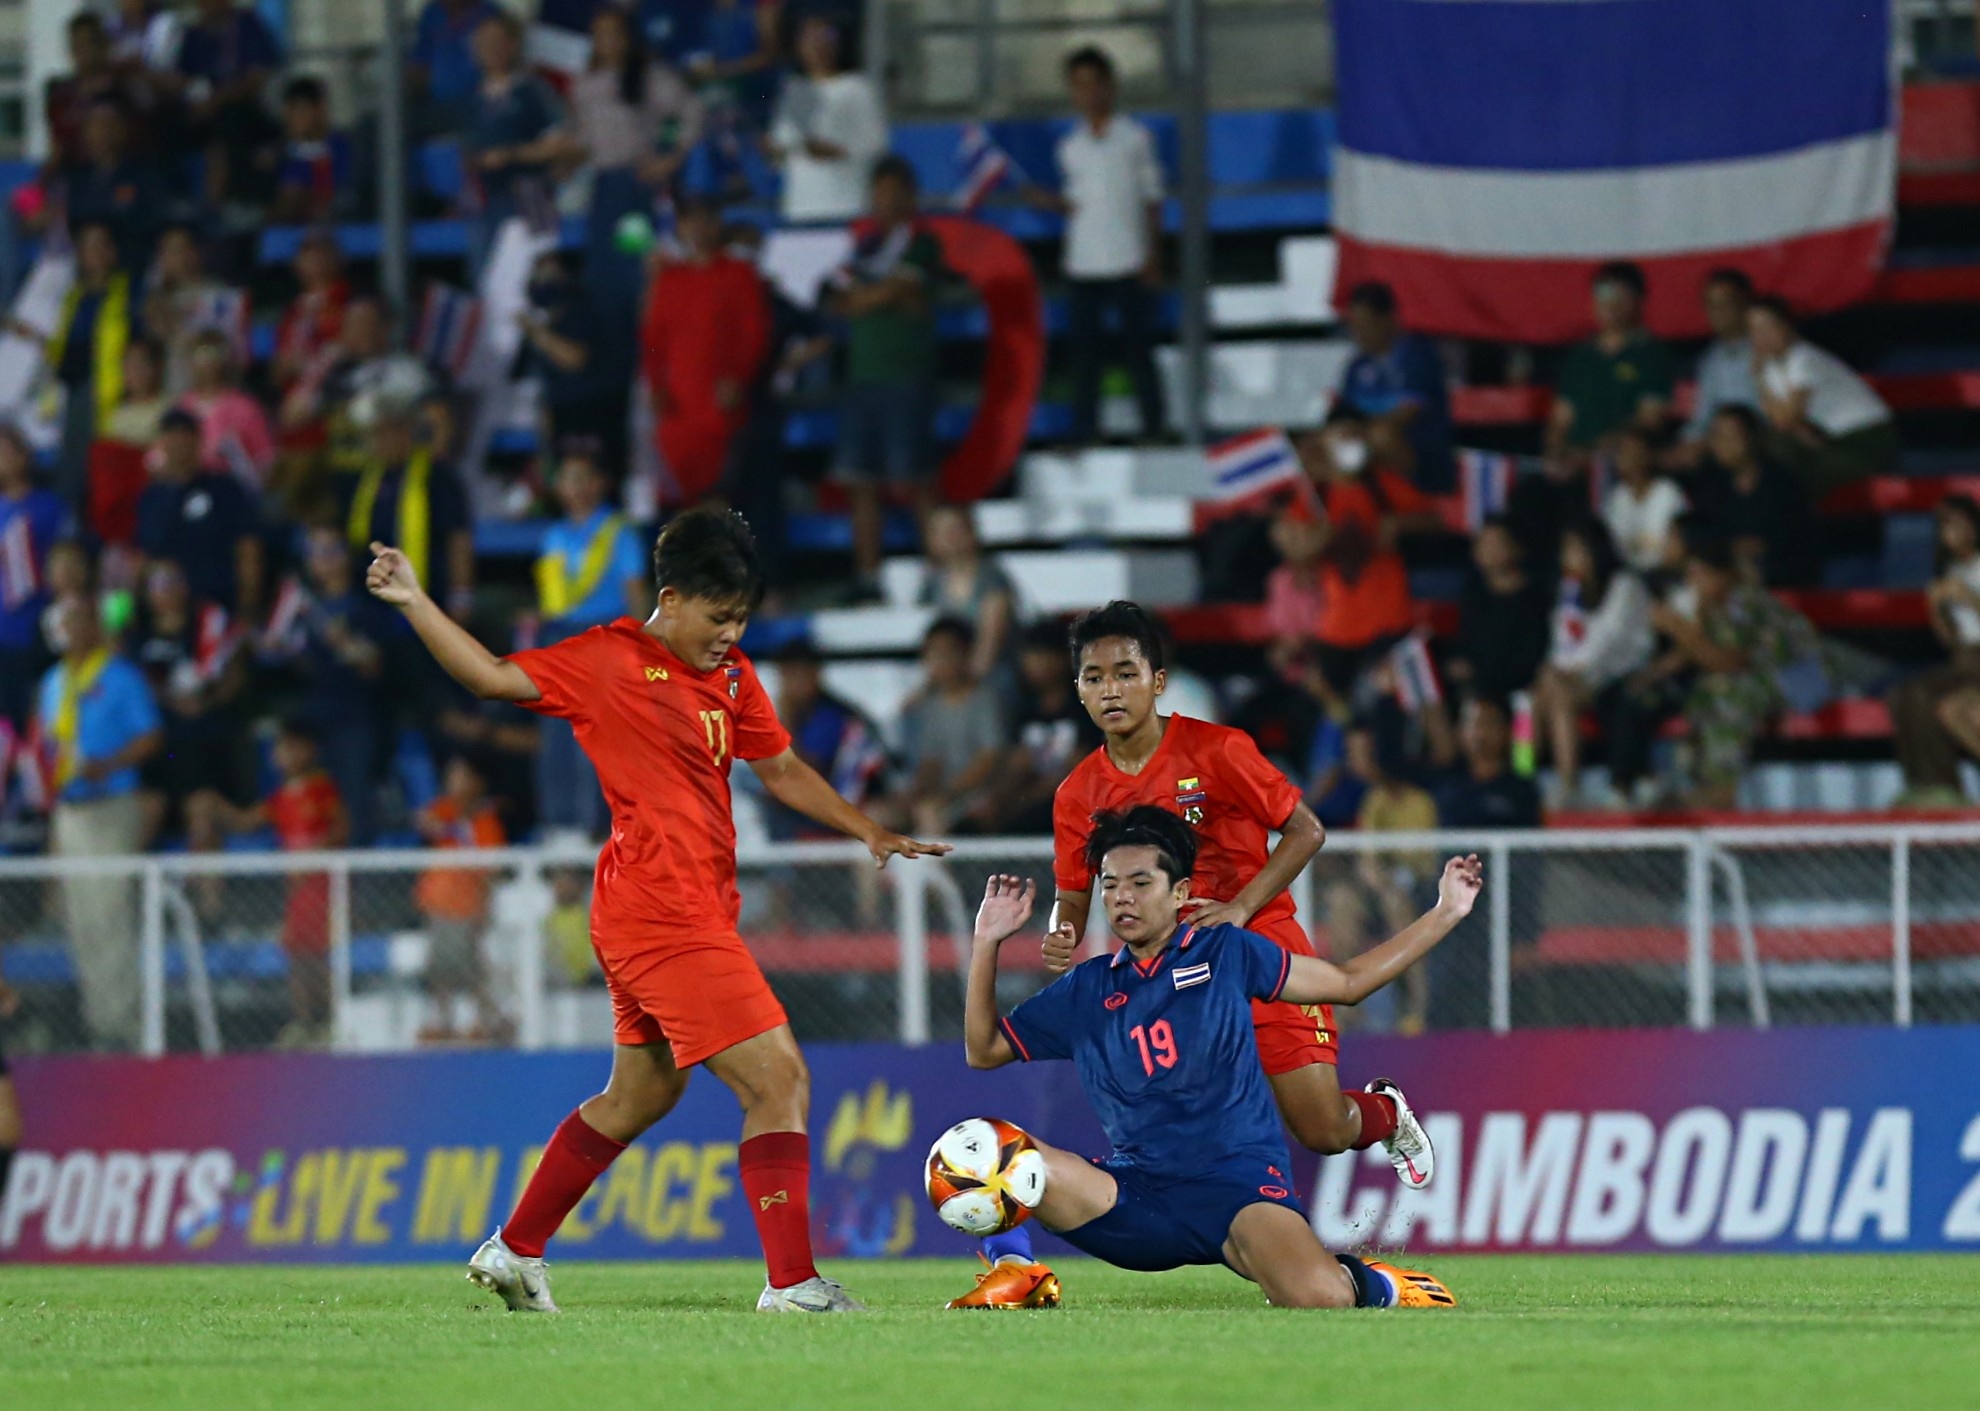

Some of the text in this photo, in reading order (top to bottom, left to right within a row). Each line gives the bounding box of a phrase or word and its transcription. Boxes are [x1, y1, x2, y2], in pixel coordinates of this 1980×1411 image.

[1129, 1018, 1179, 1078] 19
[249, 1148, 404, 1245] LIVE
[412, 1147, 500, 1244] IN
[1309, 1107, 1913, 1246] CAMBODIA
